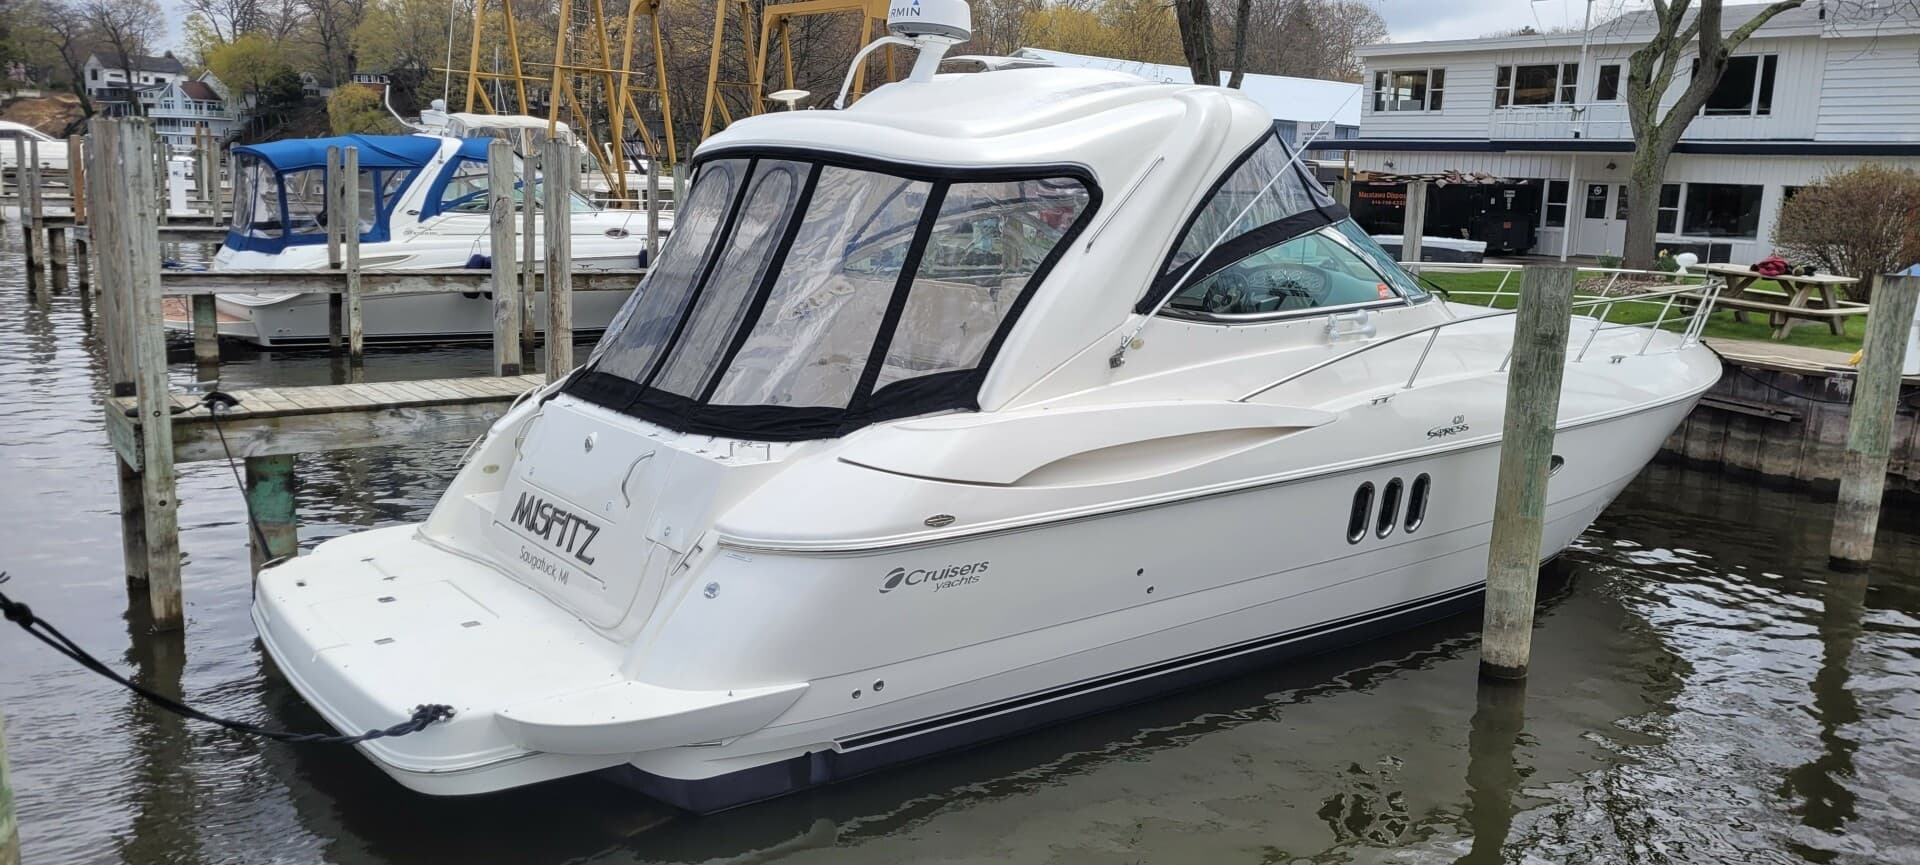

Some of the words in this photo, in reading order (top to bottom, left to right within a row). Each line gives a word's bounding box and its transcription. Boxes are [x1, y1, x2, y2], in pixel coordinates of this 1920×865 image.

[890, 7, 920, 18] RMIN
[510, 491, 600, 566] MISFITZ
[558, 567, 570, 585] MI
[904, 561, 989, 586] Cruisers
[934, 575, 980, 592] yachts
